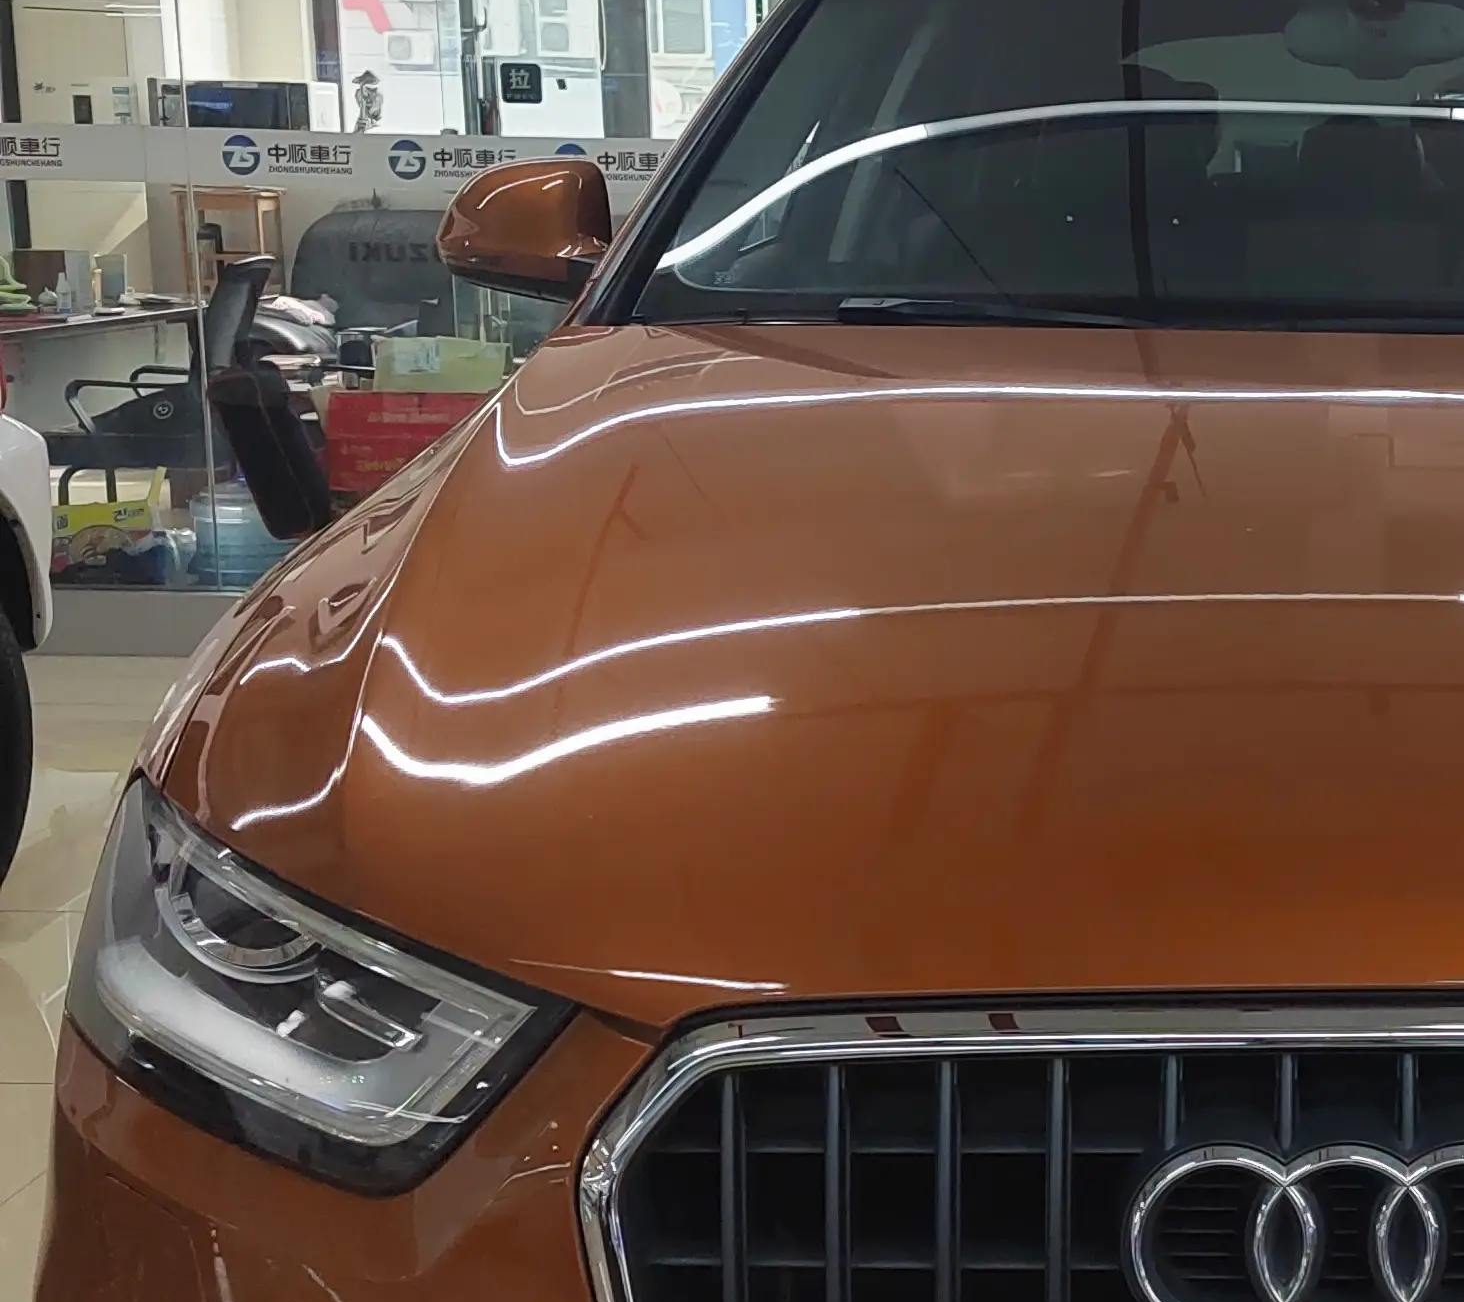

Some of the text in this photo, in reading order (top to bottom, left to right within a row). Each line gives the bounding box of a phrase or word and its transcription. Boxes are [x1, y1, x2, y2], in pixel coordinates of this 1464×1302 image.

[509, 68, 532, 90] 拉
[267, 143, 352, 165] 中顺車行
[268, 165, 353, 175] ZHONGSHUNCHEHANG
